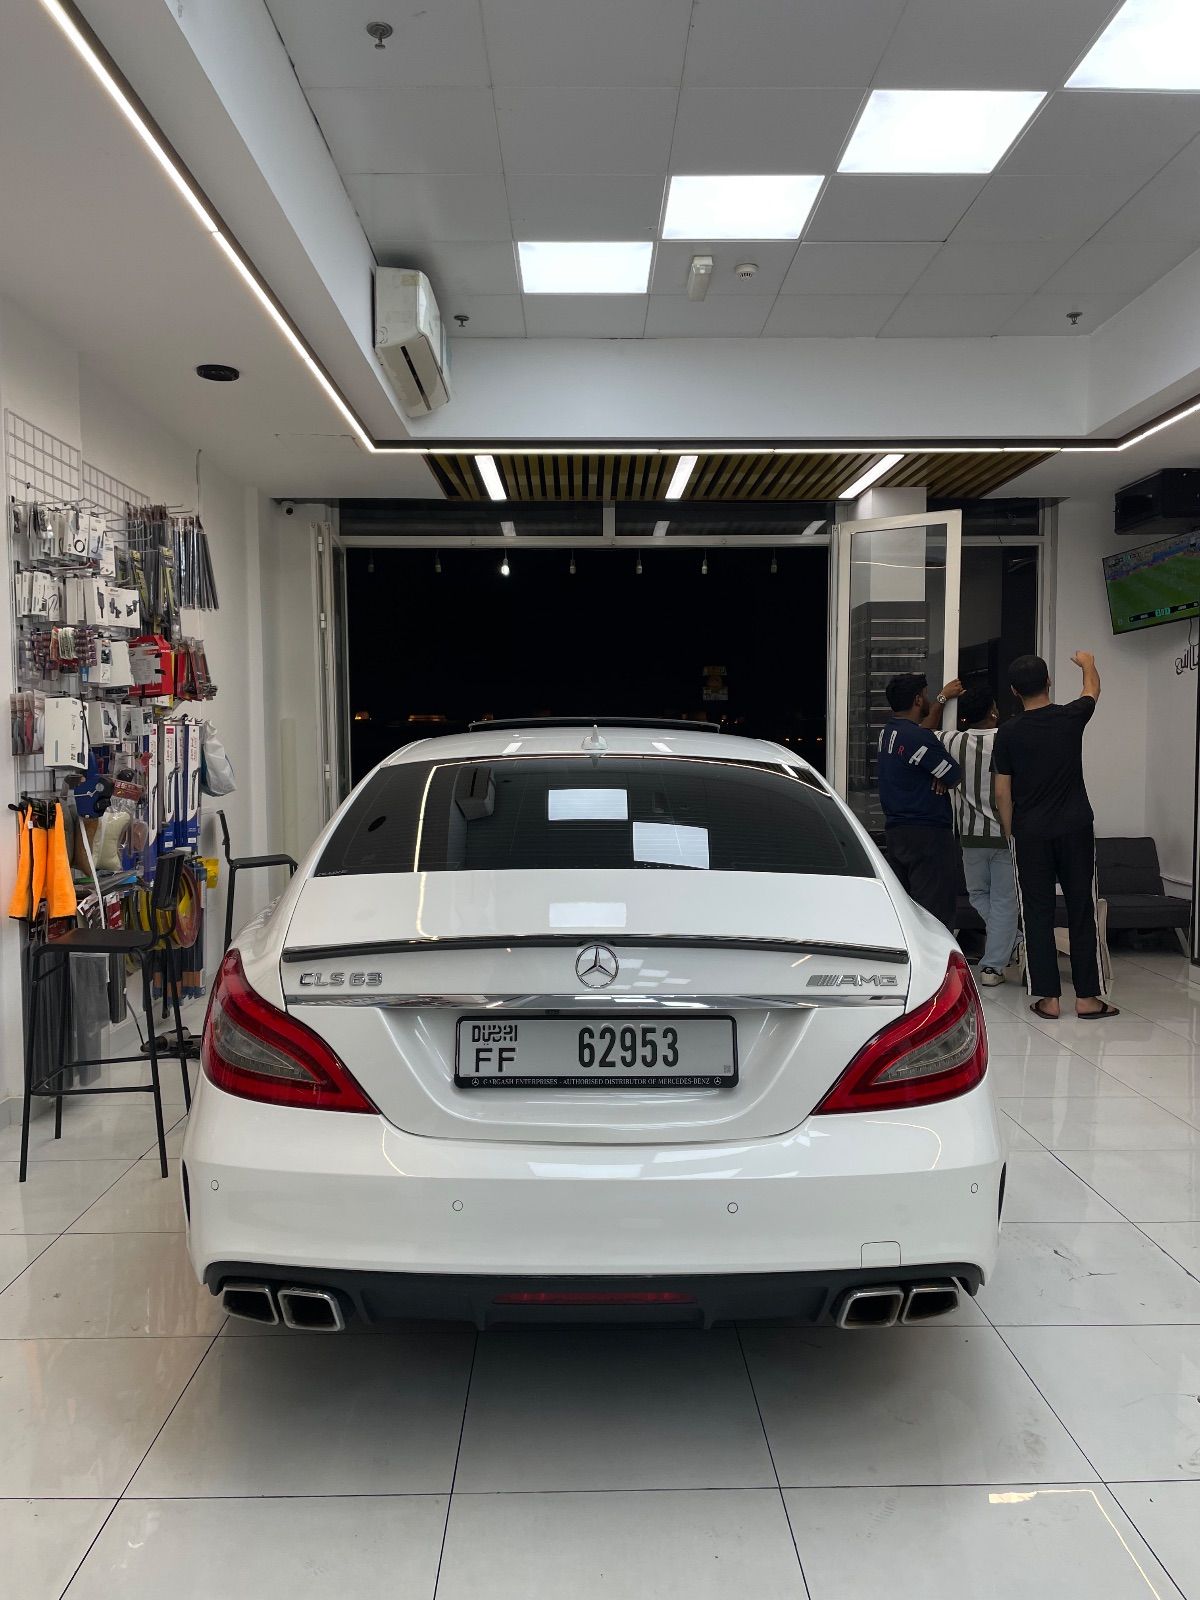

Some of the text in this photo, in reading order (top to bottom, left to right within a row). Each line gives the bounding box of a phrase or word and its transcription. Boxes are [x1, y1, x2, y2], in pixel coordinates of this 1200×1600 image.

[299, 972, 383, 987] CLS 63
[834, 974, 898, 987] AMG
[578, 1025, 680, 1068] 62953
[474, 1047, 517, 1073] FF
[658, 1077, 711, 1085] MERCEDES-BENZ
